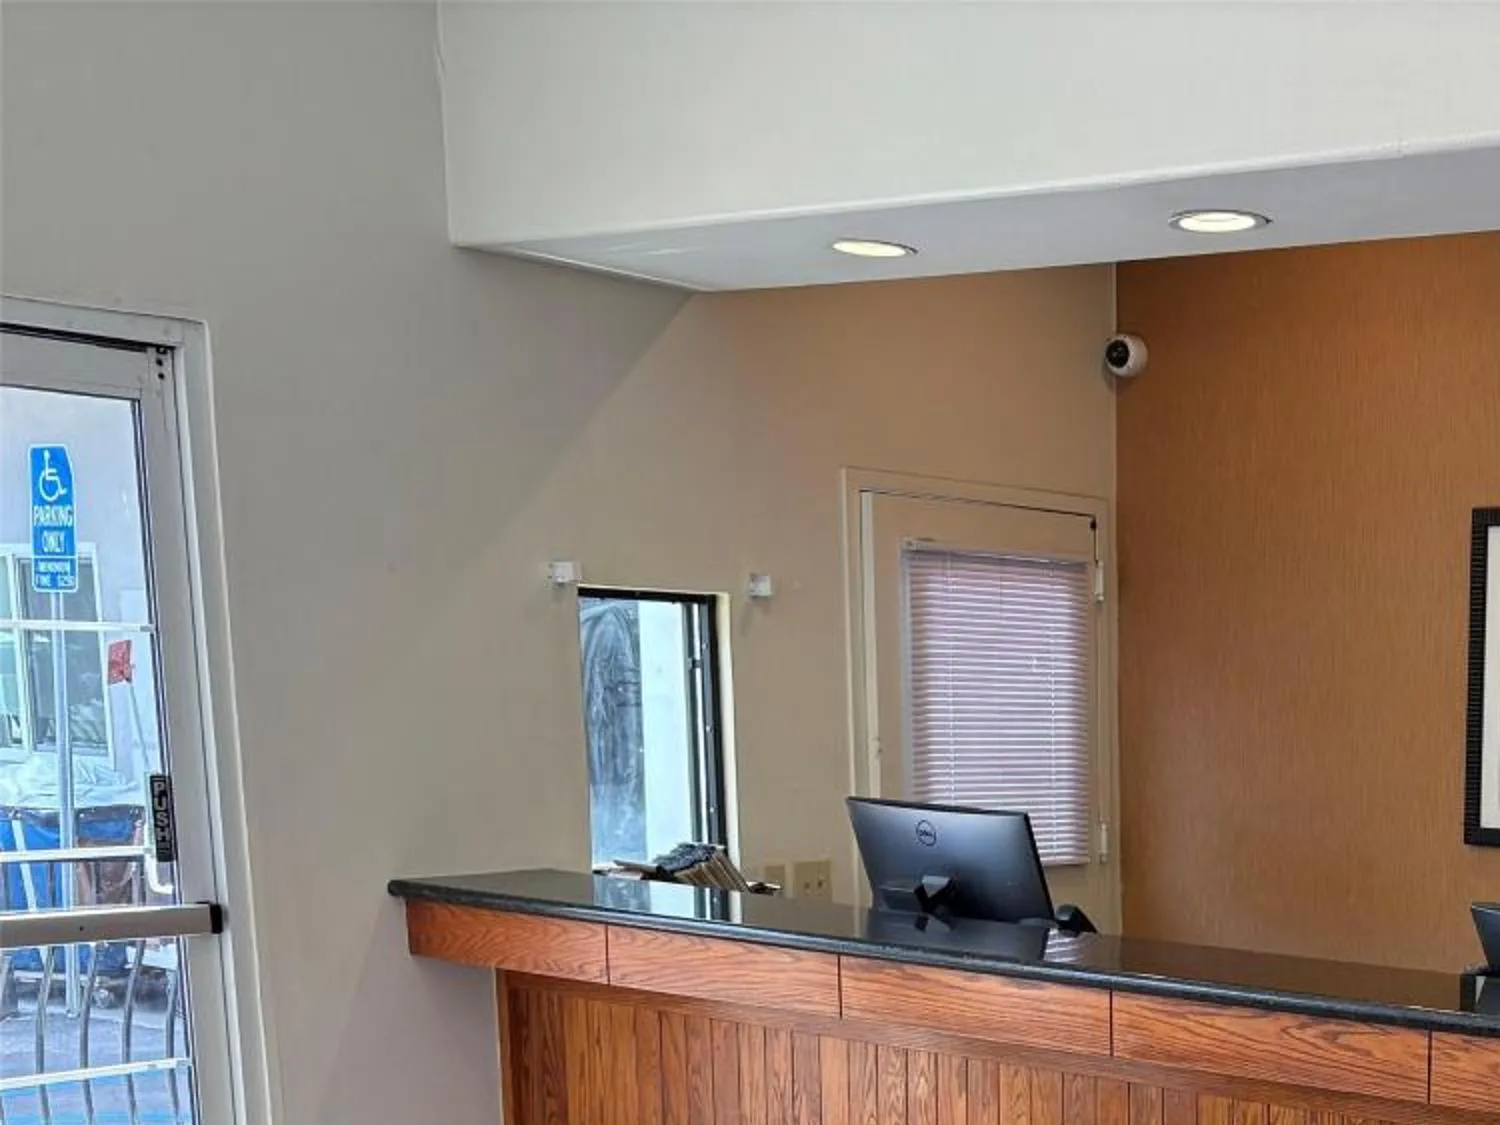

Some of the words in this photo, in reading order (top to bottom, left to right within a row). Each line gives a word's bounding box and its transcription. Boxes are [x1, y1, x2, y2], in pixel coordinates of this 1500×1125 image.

[33, 505, 73, 527] PARKING
[41, 530, 66, 553] ONLY
[153, 781, 171, 842] PUSH
